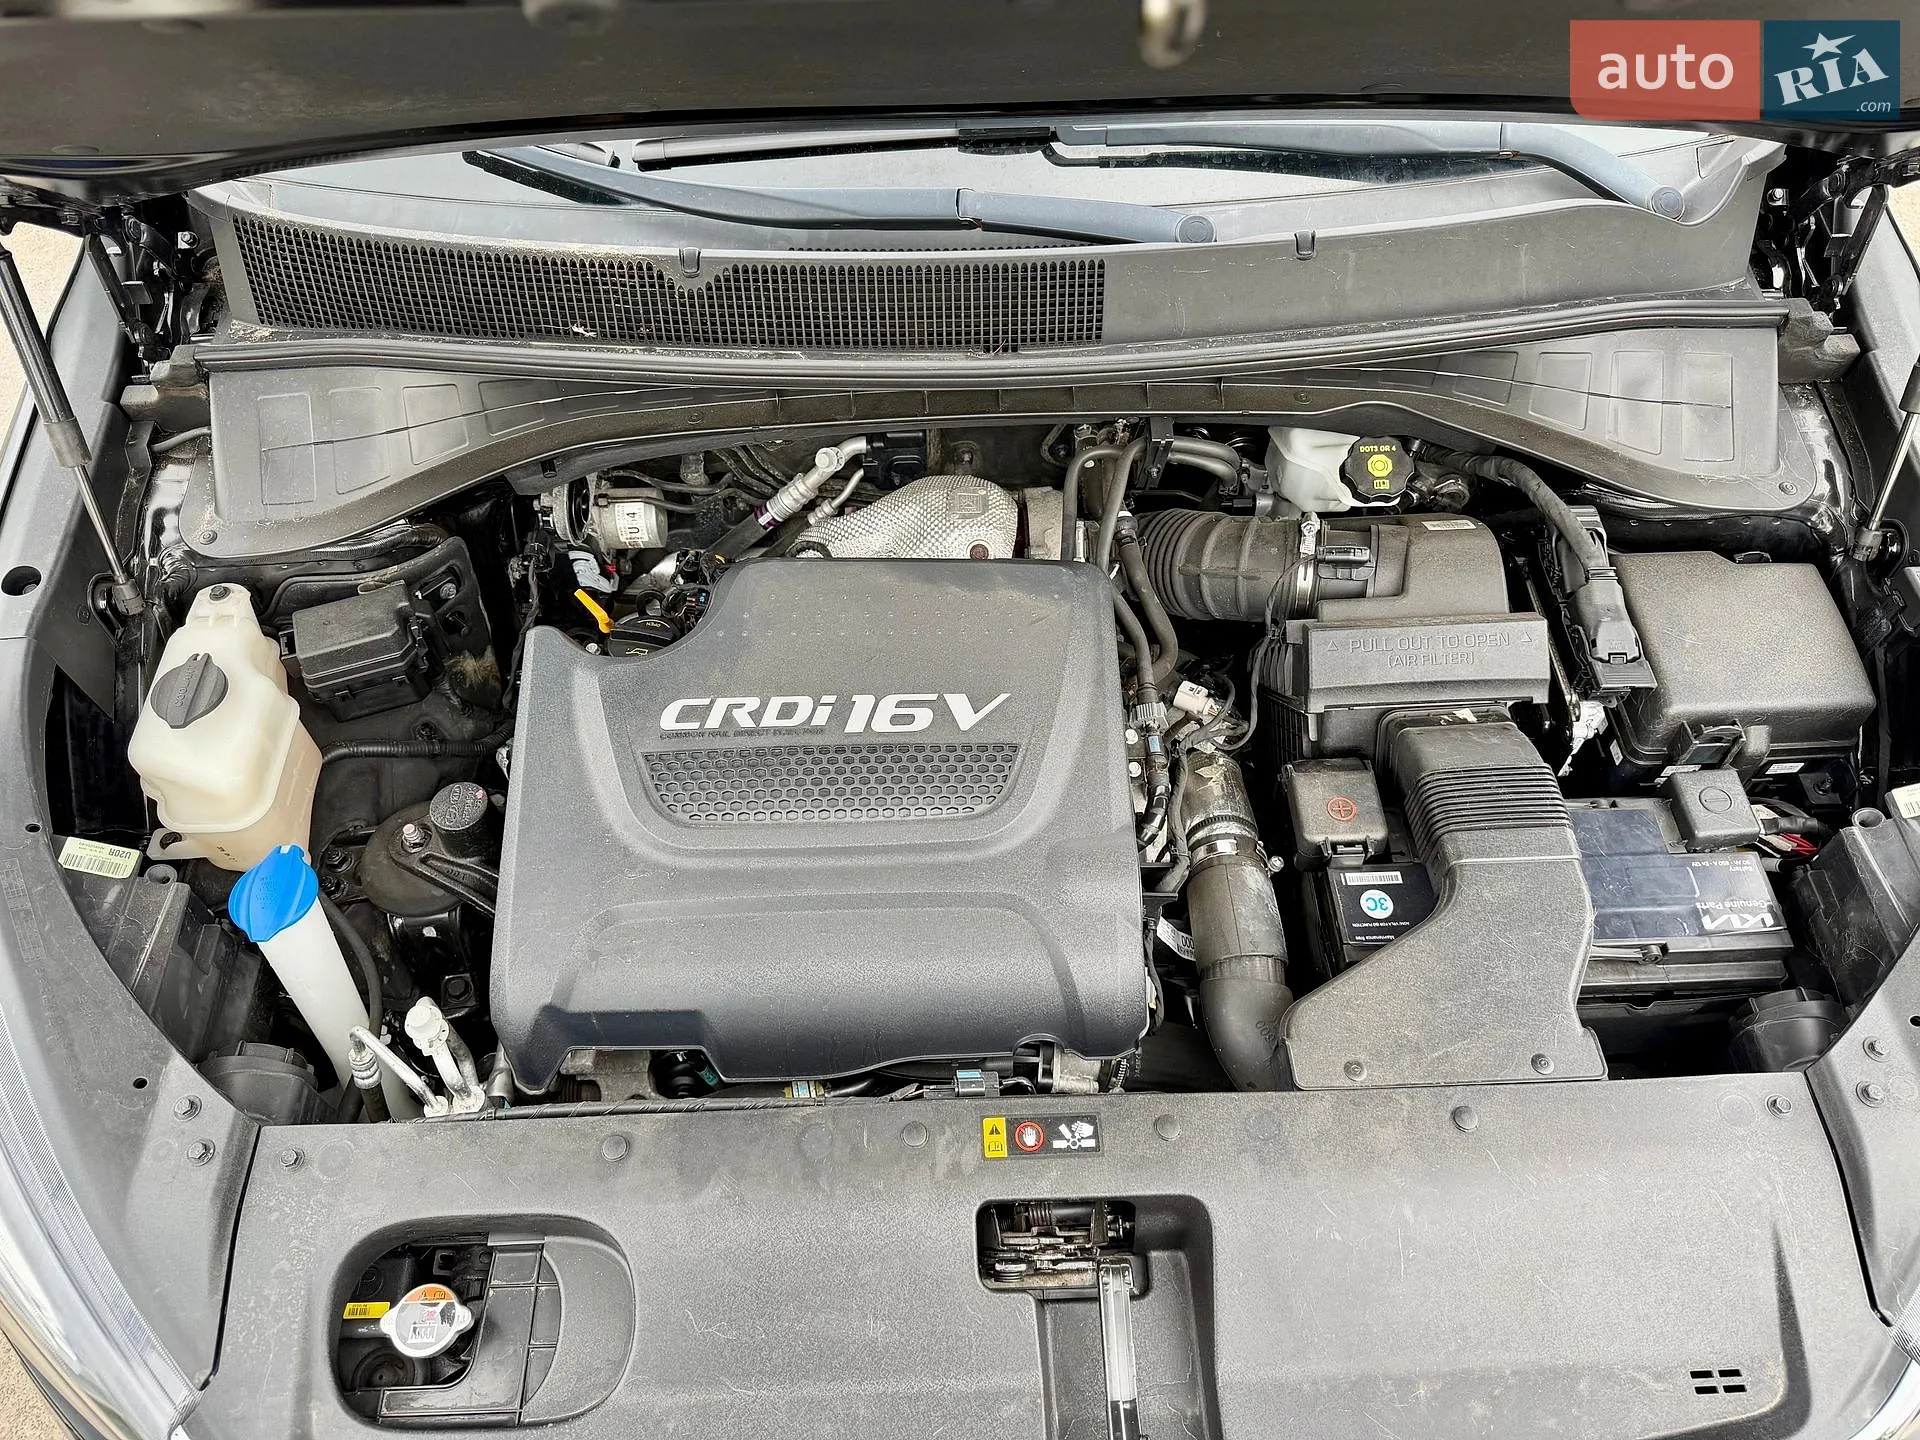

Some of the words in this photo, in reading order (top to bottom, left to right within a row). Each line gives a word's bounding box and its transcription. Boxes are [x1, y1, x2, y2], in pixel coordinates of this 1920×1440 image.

[1349, 637, 1394, 653] PULL
[1397, 635, 1432, 651] OUT
[1439, 633, 1460, 649] TO
[1464, 631, 1510, 648] OPEN
[1387, 653, 1418, 668] (AIR
[1421, 651, 1474, 666] FILTER)
[659, 694, 838, 731] CRDi
[844, 693, 1012, 733] 16V
[1365, 897, 1389, 912] 3C
[1695, 901, 1724, 910] Parts
[1725, 899, 1768, 909] Genuine
